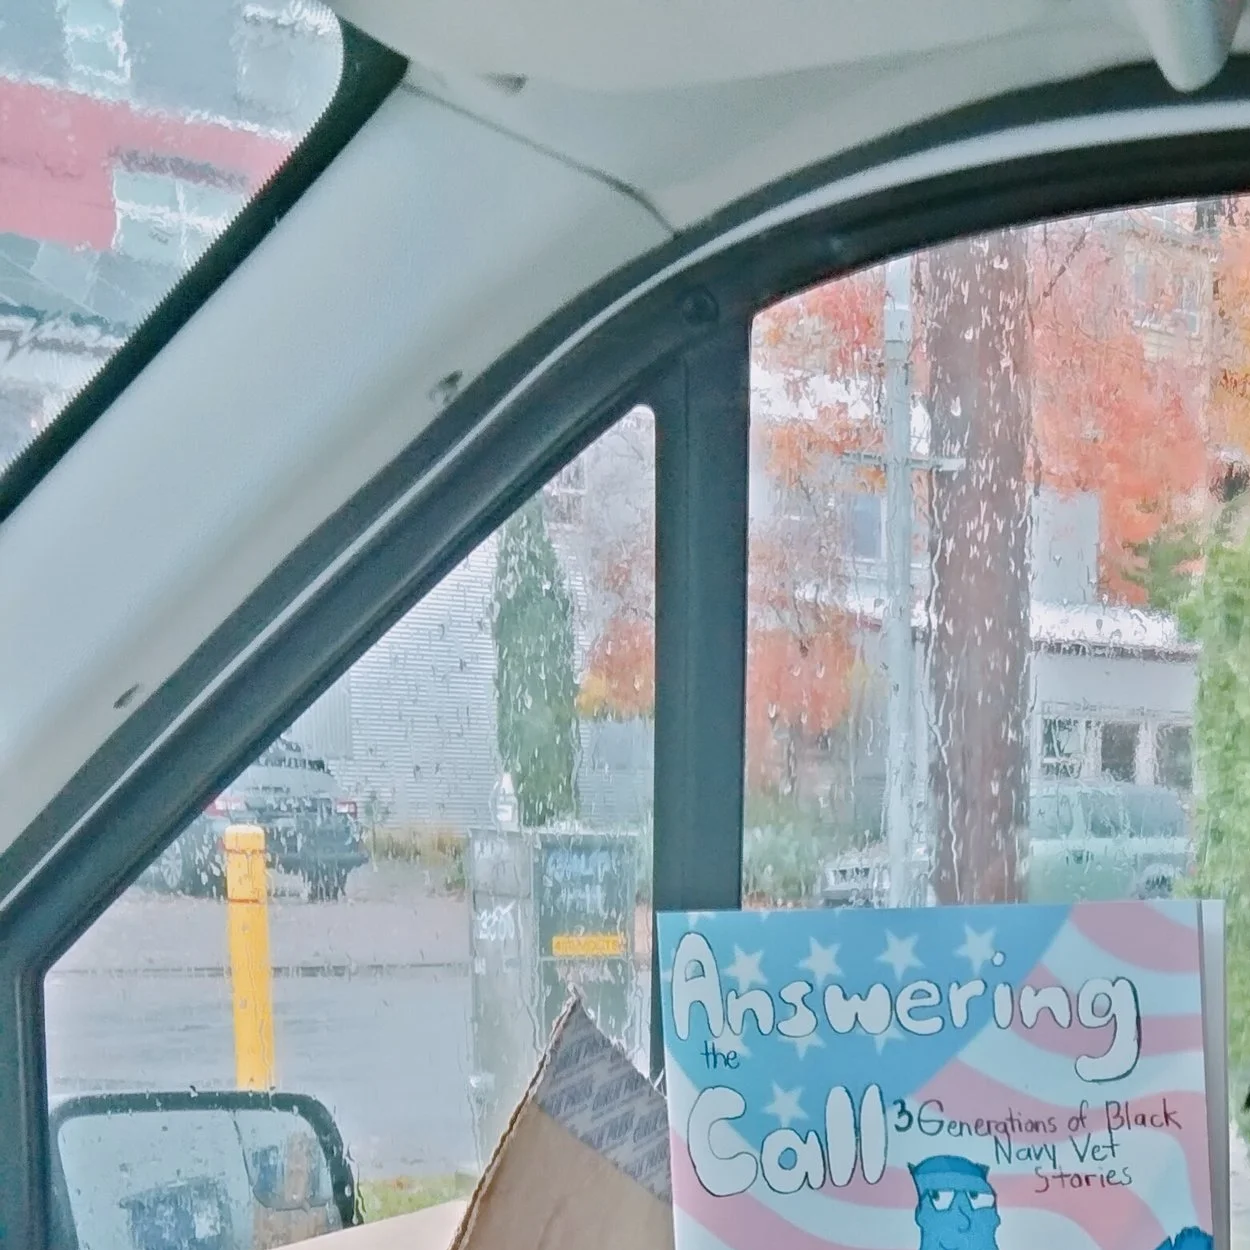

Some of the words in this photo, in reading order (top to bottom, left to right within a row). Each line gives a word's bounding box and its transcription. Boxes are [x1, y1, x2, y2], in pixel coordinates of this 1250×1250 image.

[671, 932, 1141, 1082] Answering
[701, 1042, 740, 1070] the
[892, 1098, 913, 1132] 3
[917, 1099, 1058, 1137] Generations
[1068, 1099, 1089, 1133] of
[1105, 1098, 1182, 1134] Black
[687, 1083, 888, 1197] Call
[993, 1135, 1057, 1169] Navy
[1069, 1132, 1120, 1163] Vet
[1034, 1166, 1133, 1193] Stories
